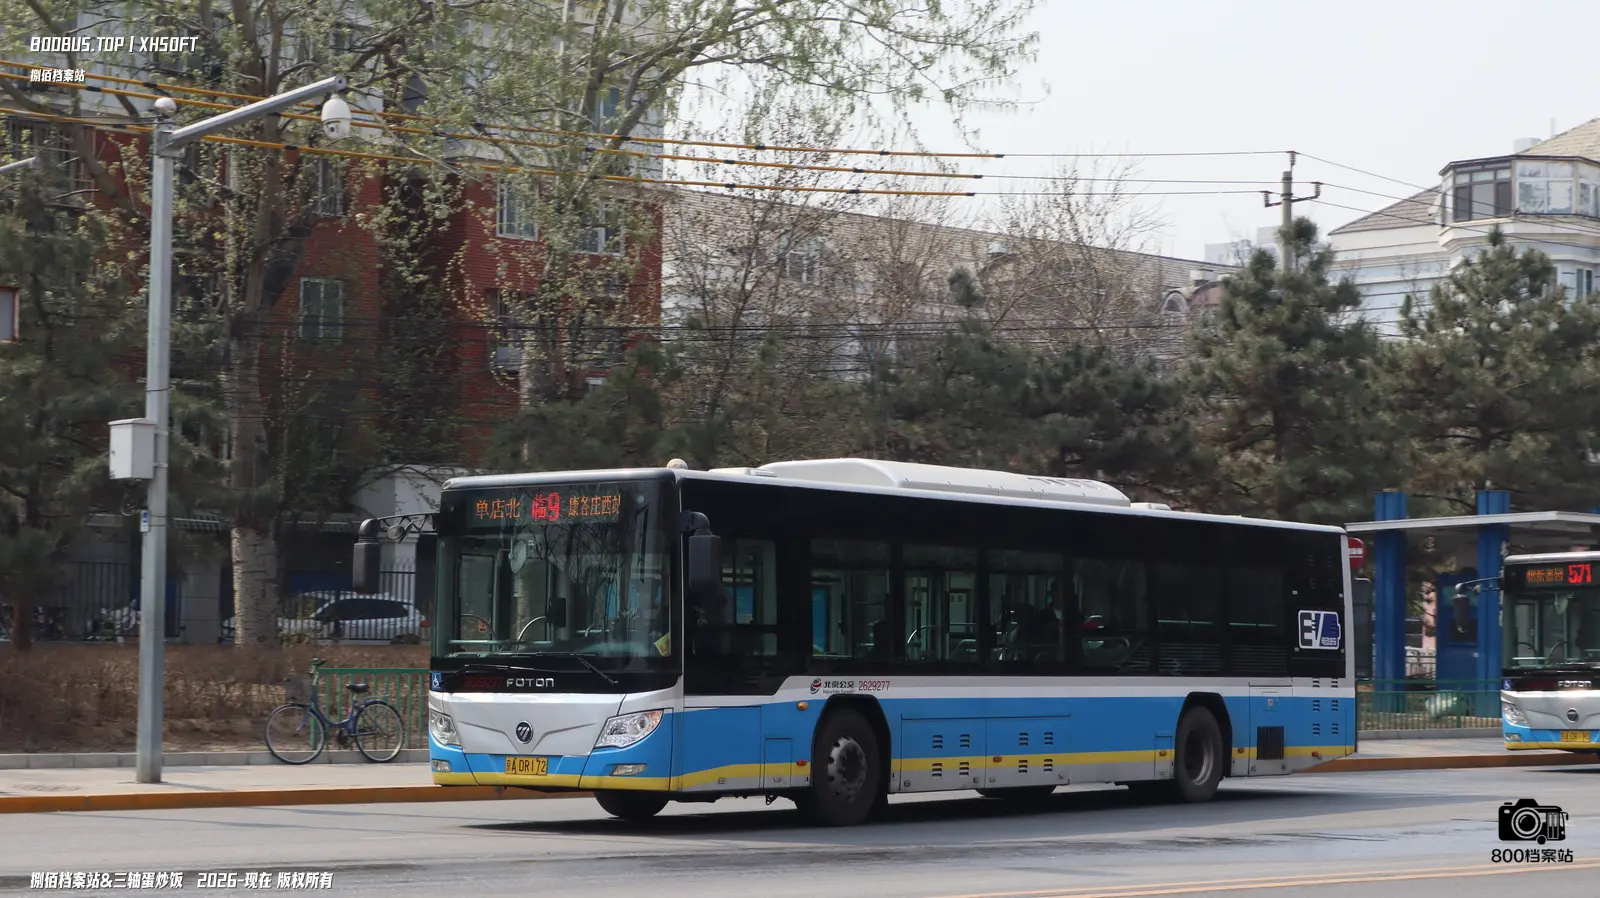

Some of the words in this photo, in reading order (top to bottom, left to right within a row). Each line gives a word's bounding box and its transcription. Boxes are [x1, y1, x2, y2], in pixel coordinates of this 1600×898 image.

[475, 498, 521, 520] 单店北
[1567, 563, 1593, 584] 571
[506, 677, 555, 688] FOTON
[824, 680, 855, 688] 北京公交
[858, 681, 890, 691] 2629277
